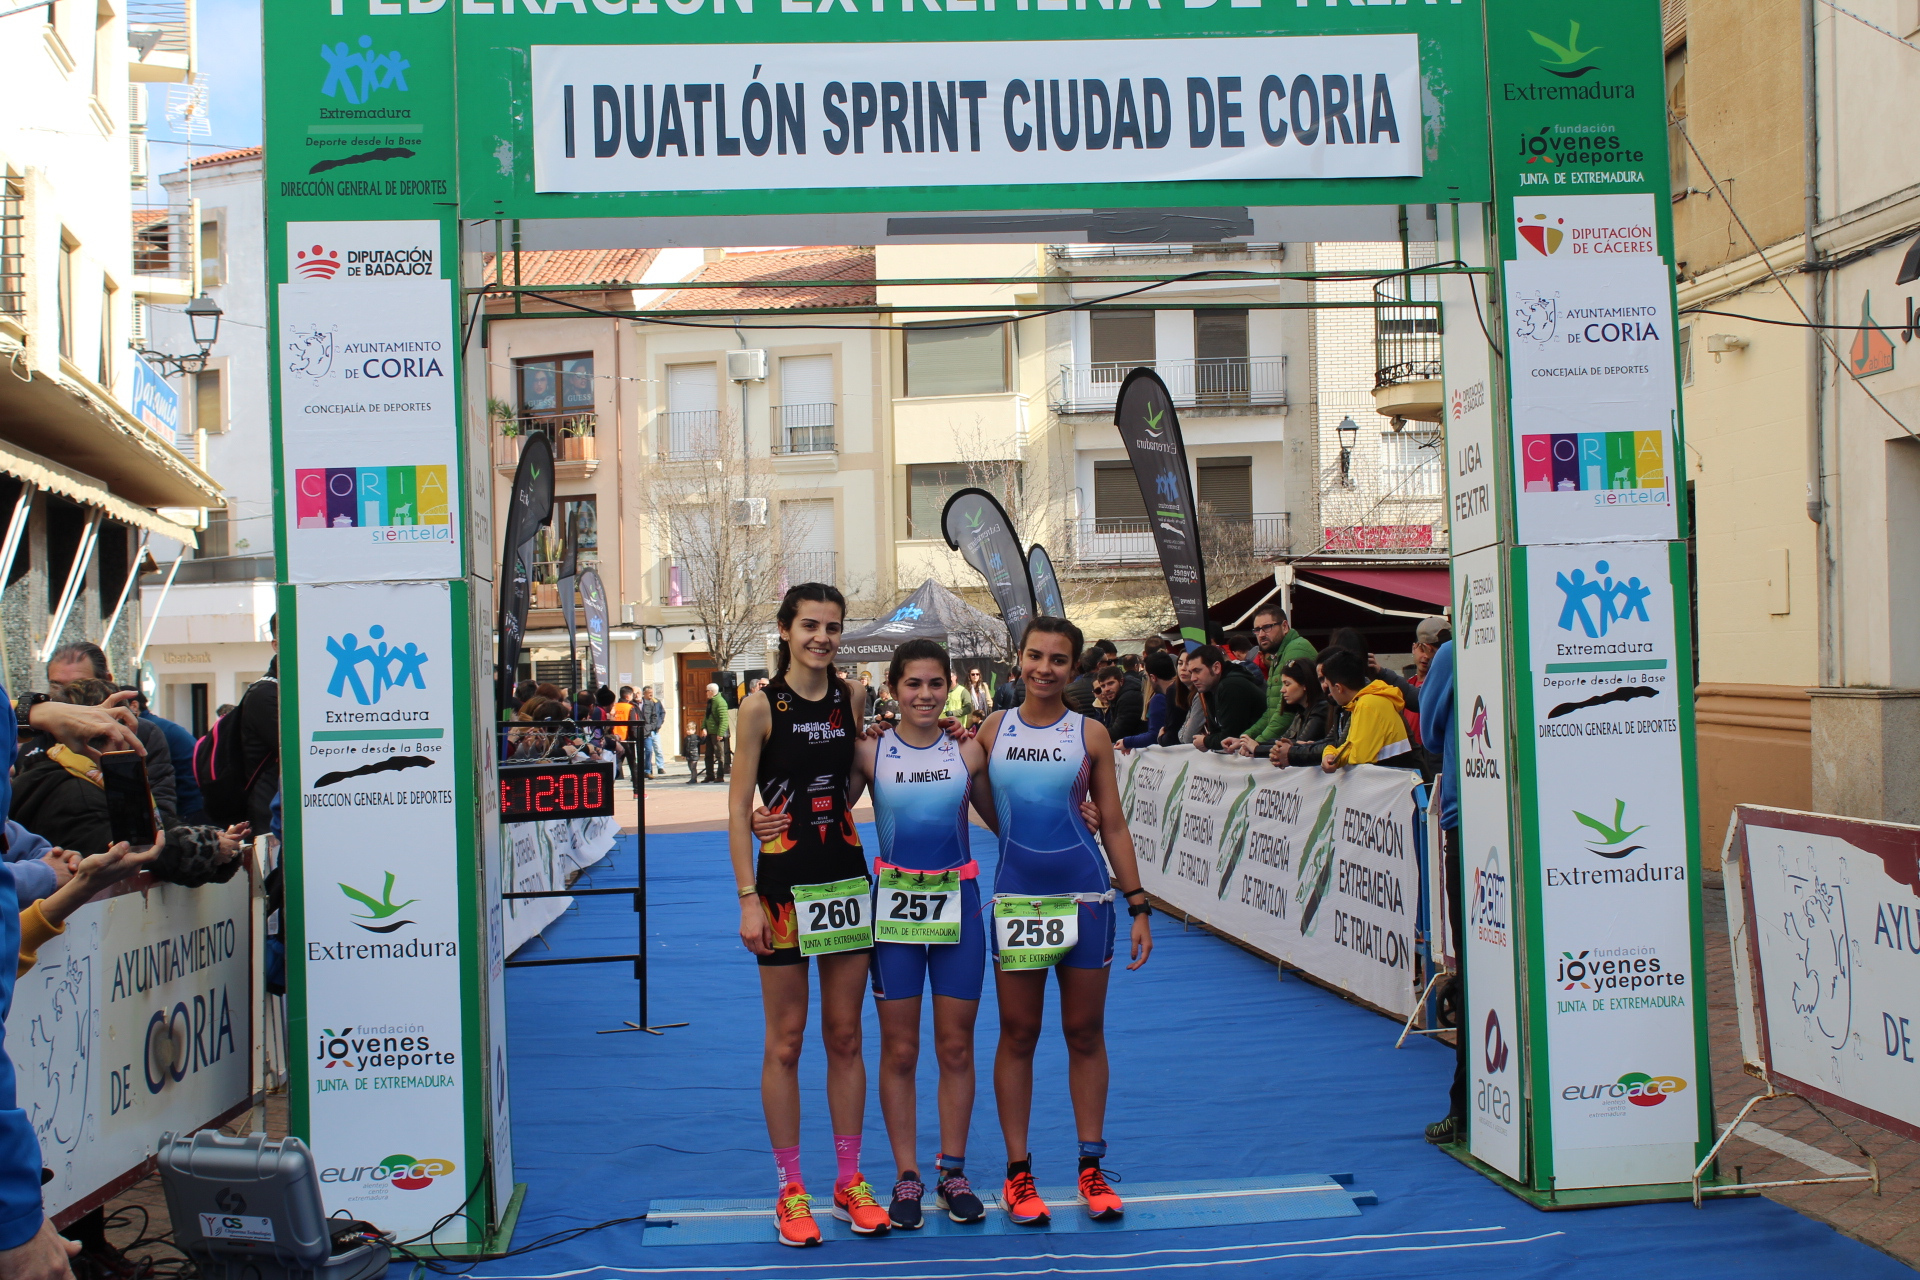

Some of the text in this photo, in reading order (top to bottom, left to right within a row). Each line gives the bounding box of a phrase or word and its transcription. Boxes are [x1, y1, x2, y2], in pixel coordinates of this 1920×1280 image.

[1504, 81, 1635, 100] Extremadura
[320, 108, 411, 118] Extremadura
[564, 64, 1400, 159] I DUATLÓN SPRINT CIUDAD DE CORIA
[1554, 123, 1615, 133] fundación
[306, 136, 421, 148] Deporte desde la Base
[1519, 127, 1620, 155] jóvenes
[281, 178, 447, 196] DIRECCIÓN GENERAL DE DEPORTES
[1519, 171, 1644, 187] JUNTA DE EXTREMADURA
[1572, 224, 1652, 240] DIPUTACIÓN
[348, 246, 433, 263] DIPUTACIÓN
[1573, 240, 1653, 254] DE CÁCERES
[348, 263, 433, 276] DE BADAJOZ
[1566, 306, 1656, 319] AYUNTAMIENTO
[1568, 322, 1660, 343] DE CORIA
[344, 341, 441, 354] AYUNTAMIENTO
[345, 358, 444, 379] DE CORIA
[1531, 365, 1649, 378] CONCEJALÍA DE DEPORTES
[567, 393, 592, 402] GUESS
[304, 402, 431, 414] CONCEJALÍA DE DEPORTES
[1459, 442, 1482, 477] LIGA
[1527, 437, 1659, 462] CORIA
[301, 471, 444, 497] CORIA
[1455, 483, 1489, 522] FEXTRI
[857, 644, 893, 654] GENERAL
[1557, 642, 1653, 656] Extremadura
[1543, 674, 1665, 689] Deporte desde la Base
[326, 709, 429, 723] Extremadura
[1539, 719, 1677, 738] DIRECCION GENERAL DE DEPORTES
[309, 743, 442, 757] Deporte desde la Base
[1006, 746, 1066, 761] MARIA C.
[895, 769, 951, 783] M. JIMÉNEZ
[1466, 758, 1500, 779] austral
[304, 790, 452, 807] DIRECCION GENERAL DE DEPORTES
[1255, 787, 1303, 826] FEDERACIÓN
[1183, 813, 1214, 846] EXTREMEÑA
[1342, 807, 1404, 860] FEDERACIÓN
[1248, 831, 1290, 872] EXTREMEÑA
[1547, 863, 1685, 886] Extremadura
[1241, 874, 1287, 920] DE TRIATLON
[1339, 859, 1405, 916] EXTREMEÑA
[809, 898, 860, 931] 260
[890, 892, 948, 921] 257
[804, 933, 870, 949] JUNTA DE EXTREMADURA
[880, 926, 898, 935] JUNTA
[912, 928, 956, 936] EXTREMADURA
[1007, 919, 1065, 947] 258
[1334, 909, 1410, 972] DE TRIATLON
[1479, 926, 1506, 947] BICICLETAS
[308, 938, 456, 961] Extremadura
[1002, 954, 1027, 964] JUNTA DE
[1593, 945, 1656, 957] fundación
[111, 918, 235, 1003] AYUNTAMIENTO
[1557, 951, 1661, 982] jóvenes
[1557, 995, 1685, 1015] JUNTA DE EXTREMADURA
[357, 1023, 424, 1035] fundación
[1882, 1011, 1914, 1064] DE
[111, 983, 235, 1116] DE CORIA
[317, 1028, 429, 1060] jóvenes
[317, 1074, 454, 1094] JUNTA DE EXTREMADURA
[1562, 1080, 1676, 1101] euroace
[1478, 1078, 1511, 1124] area
[320, 1162, 443, 1183] euroace
[348, 1194, 388, 1202] extremadura
[222, 1216, 243, 1229] CS
